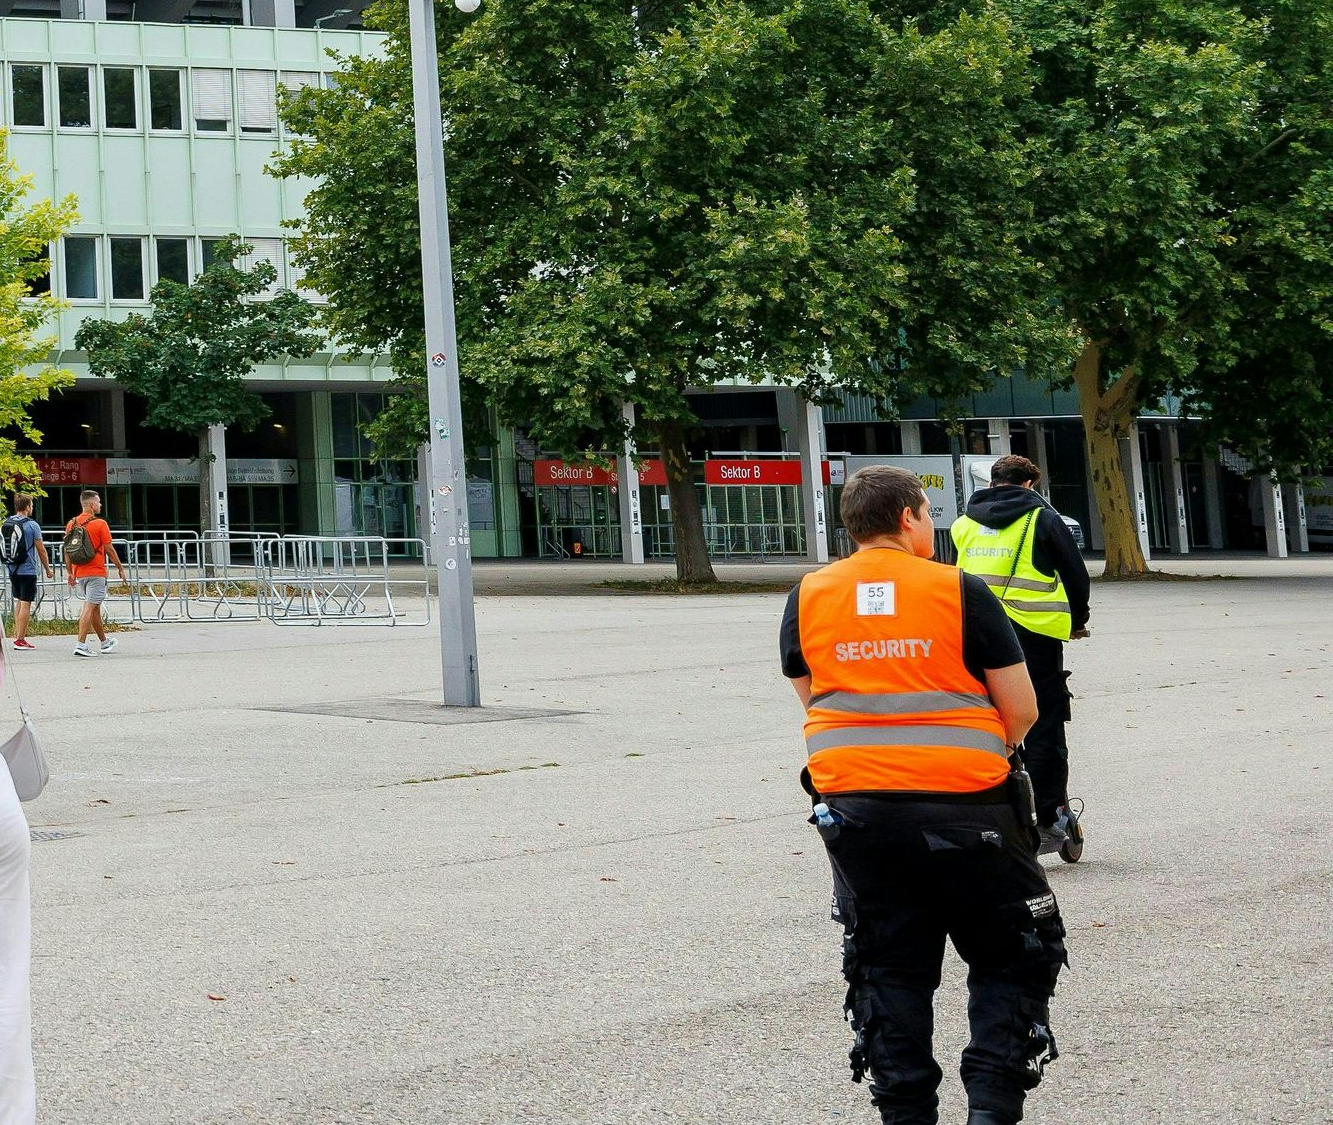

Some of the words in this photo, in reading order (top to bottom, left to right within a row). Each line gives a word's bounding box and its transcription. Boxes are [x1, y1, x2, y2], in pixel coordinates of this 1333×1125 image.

[59, 460, 79, 471] Rang
[720, 465, 751, 478] Sektor
[753, 465, 760, 478] B
[60, 472, 66, 481] 5
[71, 472, 78, 481] 6
[550, 465, 583, 479] Sektor
[586, 467, 593, 479] B
[965, 547, 1014, 558] SECURITY
[868, 586, 885, 598] 55
[835, 638, 932, 662] SECURITY
